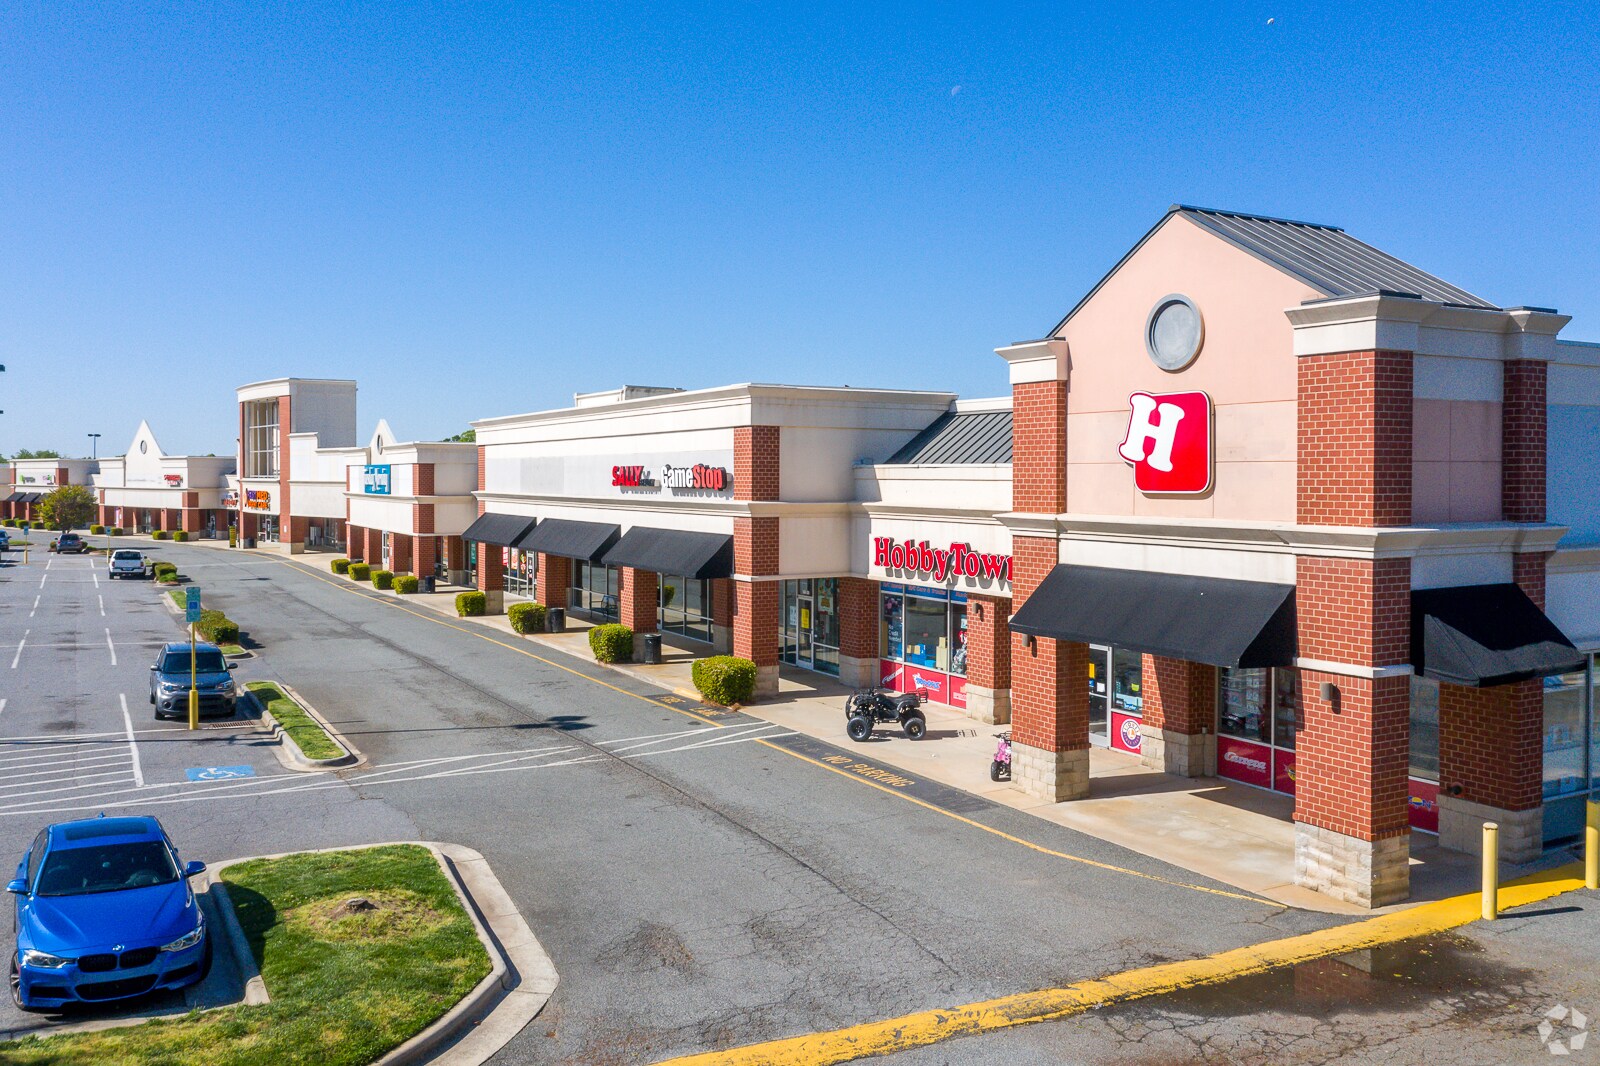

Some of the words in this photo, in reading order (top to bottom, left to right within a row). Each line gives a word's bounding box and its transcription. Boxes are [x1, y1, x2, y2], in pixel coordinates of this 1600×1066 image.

[1119, 394, 1185, 472] H
[612, 466, 643, 487] SALLY
[661, 464, 724, 490] GameStop
[821, 755, 853, 764] NO
[844, 763, 916, 787] PARKING
